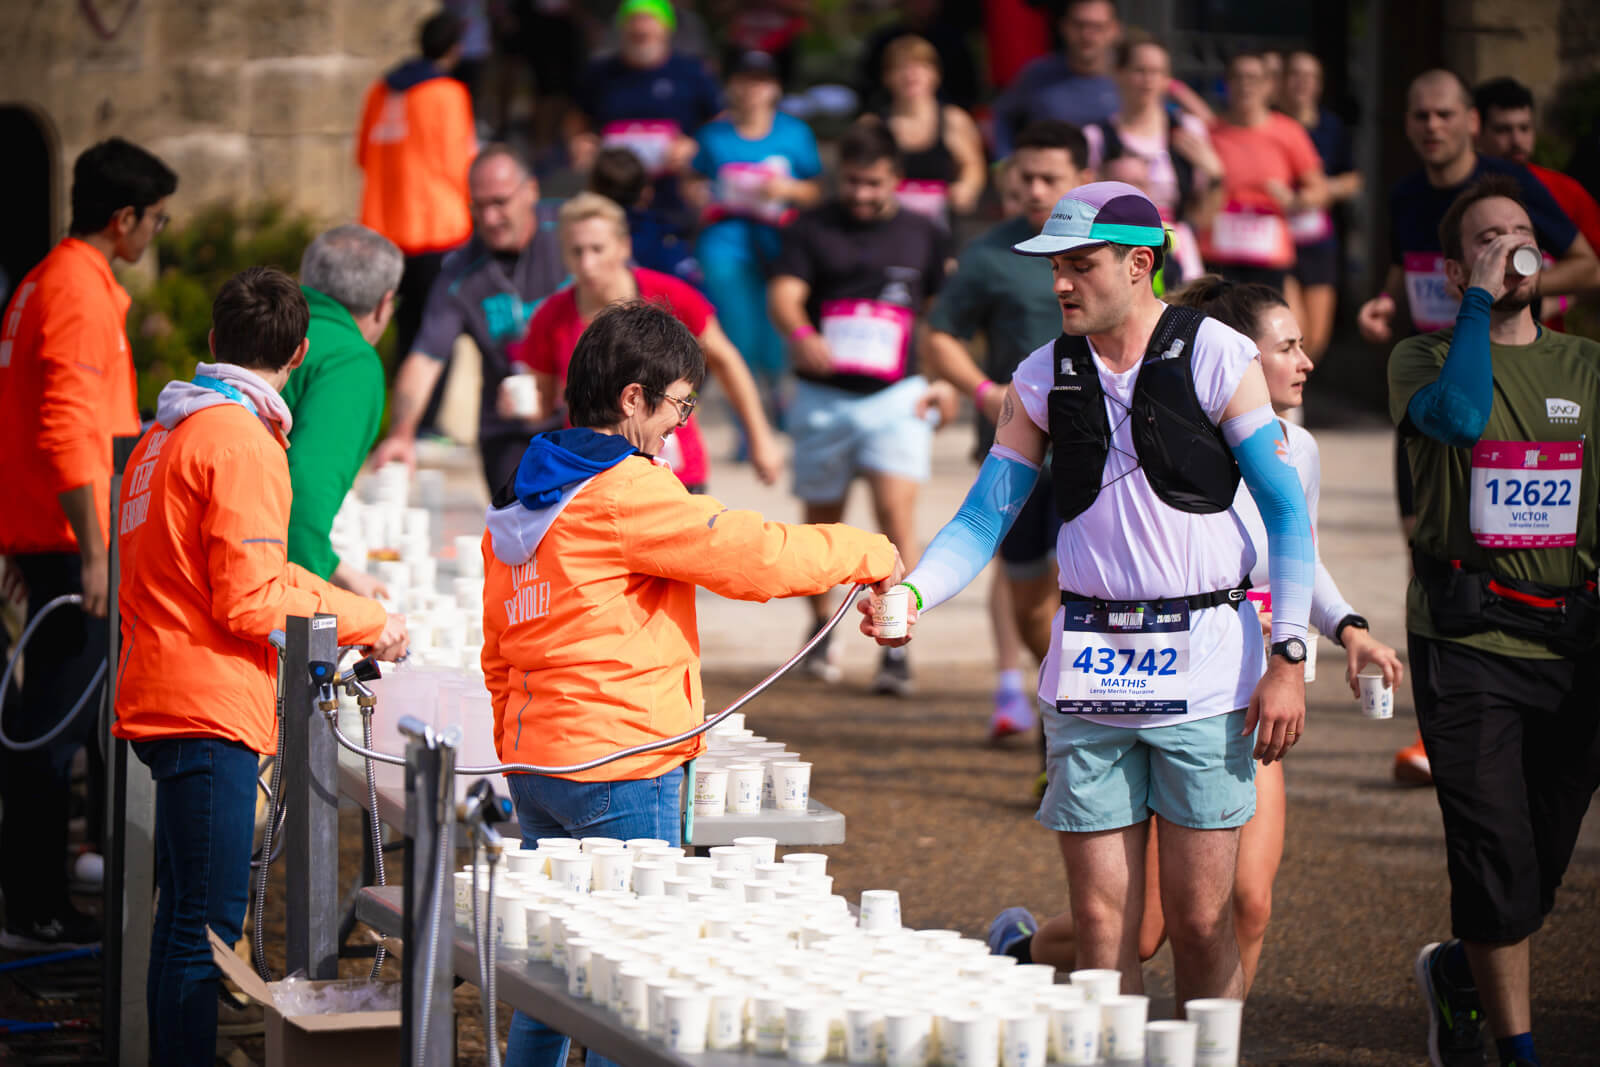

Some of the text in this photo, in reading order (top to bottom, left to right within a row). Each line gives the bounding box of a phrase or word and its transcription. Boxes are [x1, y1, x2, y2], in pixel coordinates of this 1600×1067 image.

[1550, 405, 1578, 415] SNCF
[1485, 478, 1572, 506] 12622
[1511, 511, 1549, 521] VICTOR
[1108, 612, 1144, 626] MARATHON
[1072, 646, 1178, 676] 43742
[1100, 678, 1147, 688] MATHIS
